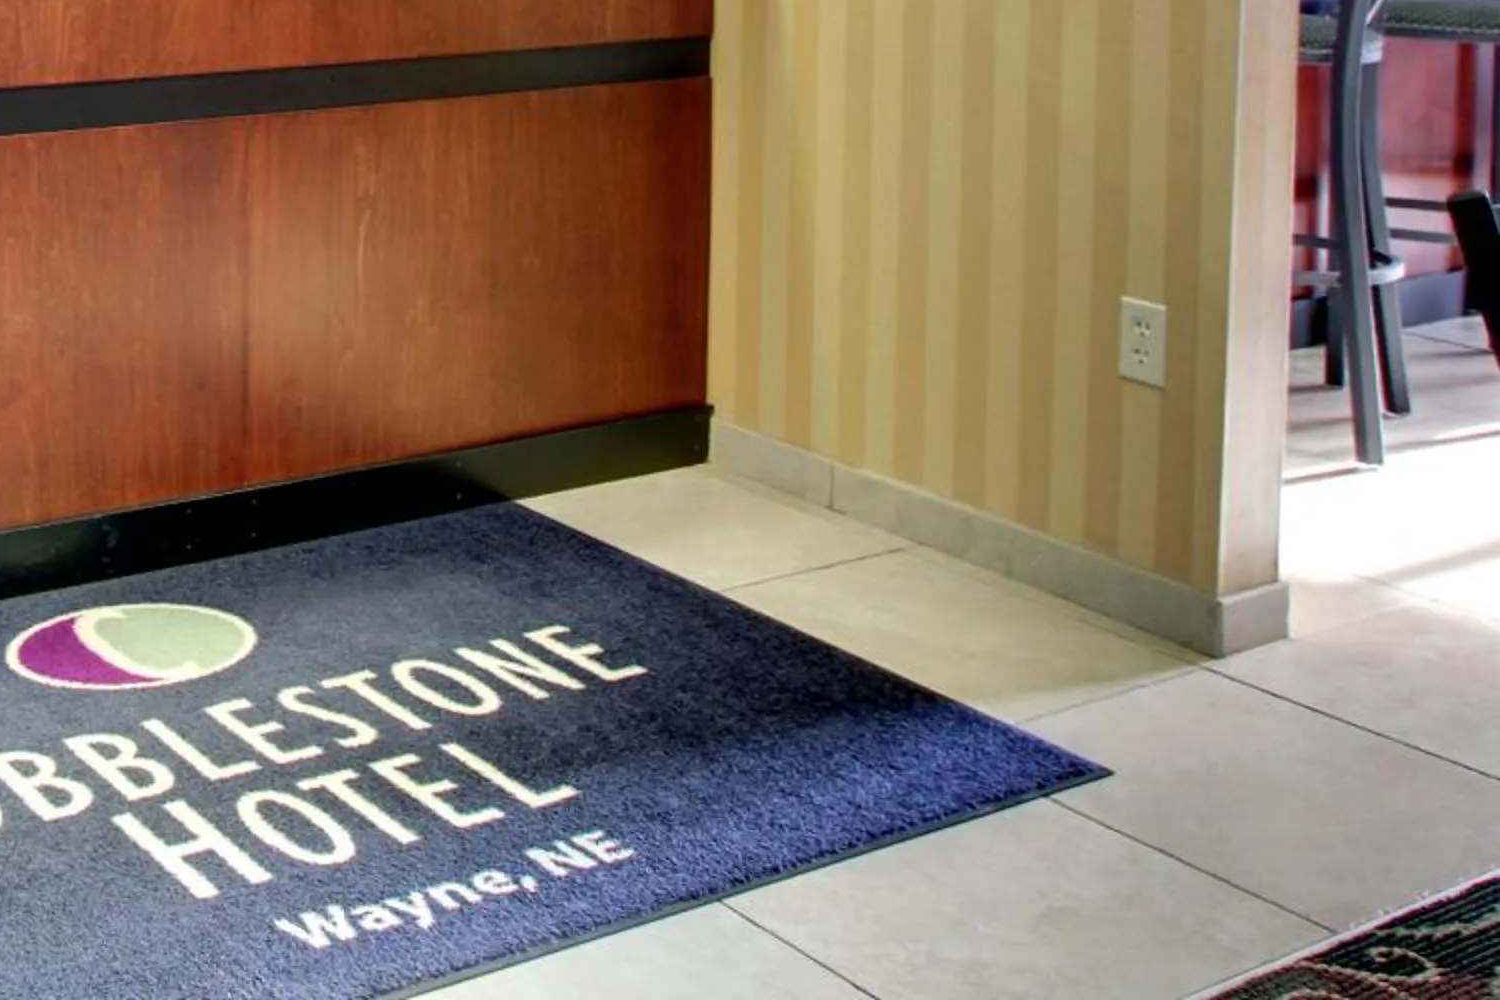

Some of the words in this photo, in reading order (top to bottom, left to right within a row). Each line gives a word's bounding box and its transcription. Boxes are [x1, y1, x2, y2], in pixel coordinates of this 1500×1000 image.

[112, 743, 579, 899] HOTEL
[274, 868, 537, 949] Wayne,
[526, 829, 635, 877] NE
